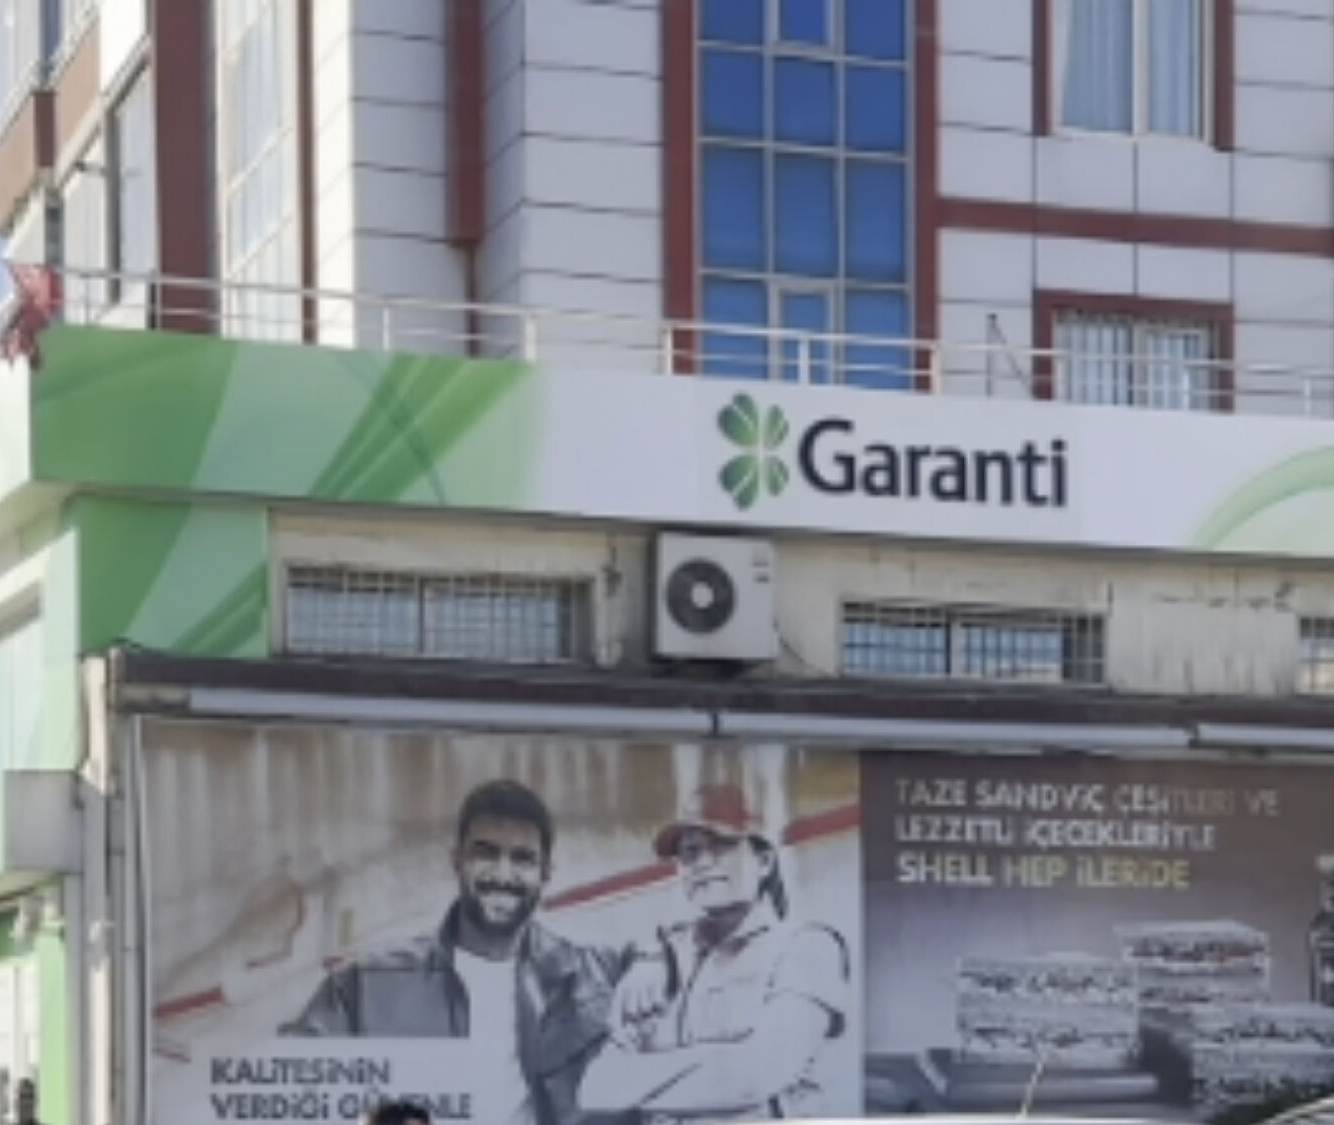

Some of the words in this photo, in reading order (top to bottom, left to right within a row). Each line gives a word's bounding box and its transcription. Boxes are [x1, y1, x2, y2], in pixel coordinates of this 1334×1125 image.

[798, 417, 1068, 506] Garanti
[896, 779, 966, 807] TAZE
[897, 851, 994, 884] SHELL
[1006, 856, 1064, 887] HEP
[211, 1058, 391, 1084] KALİTESİNİN
[211, 1089, 329, 1119] VERDİĞİ
